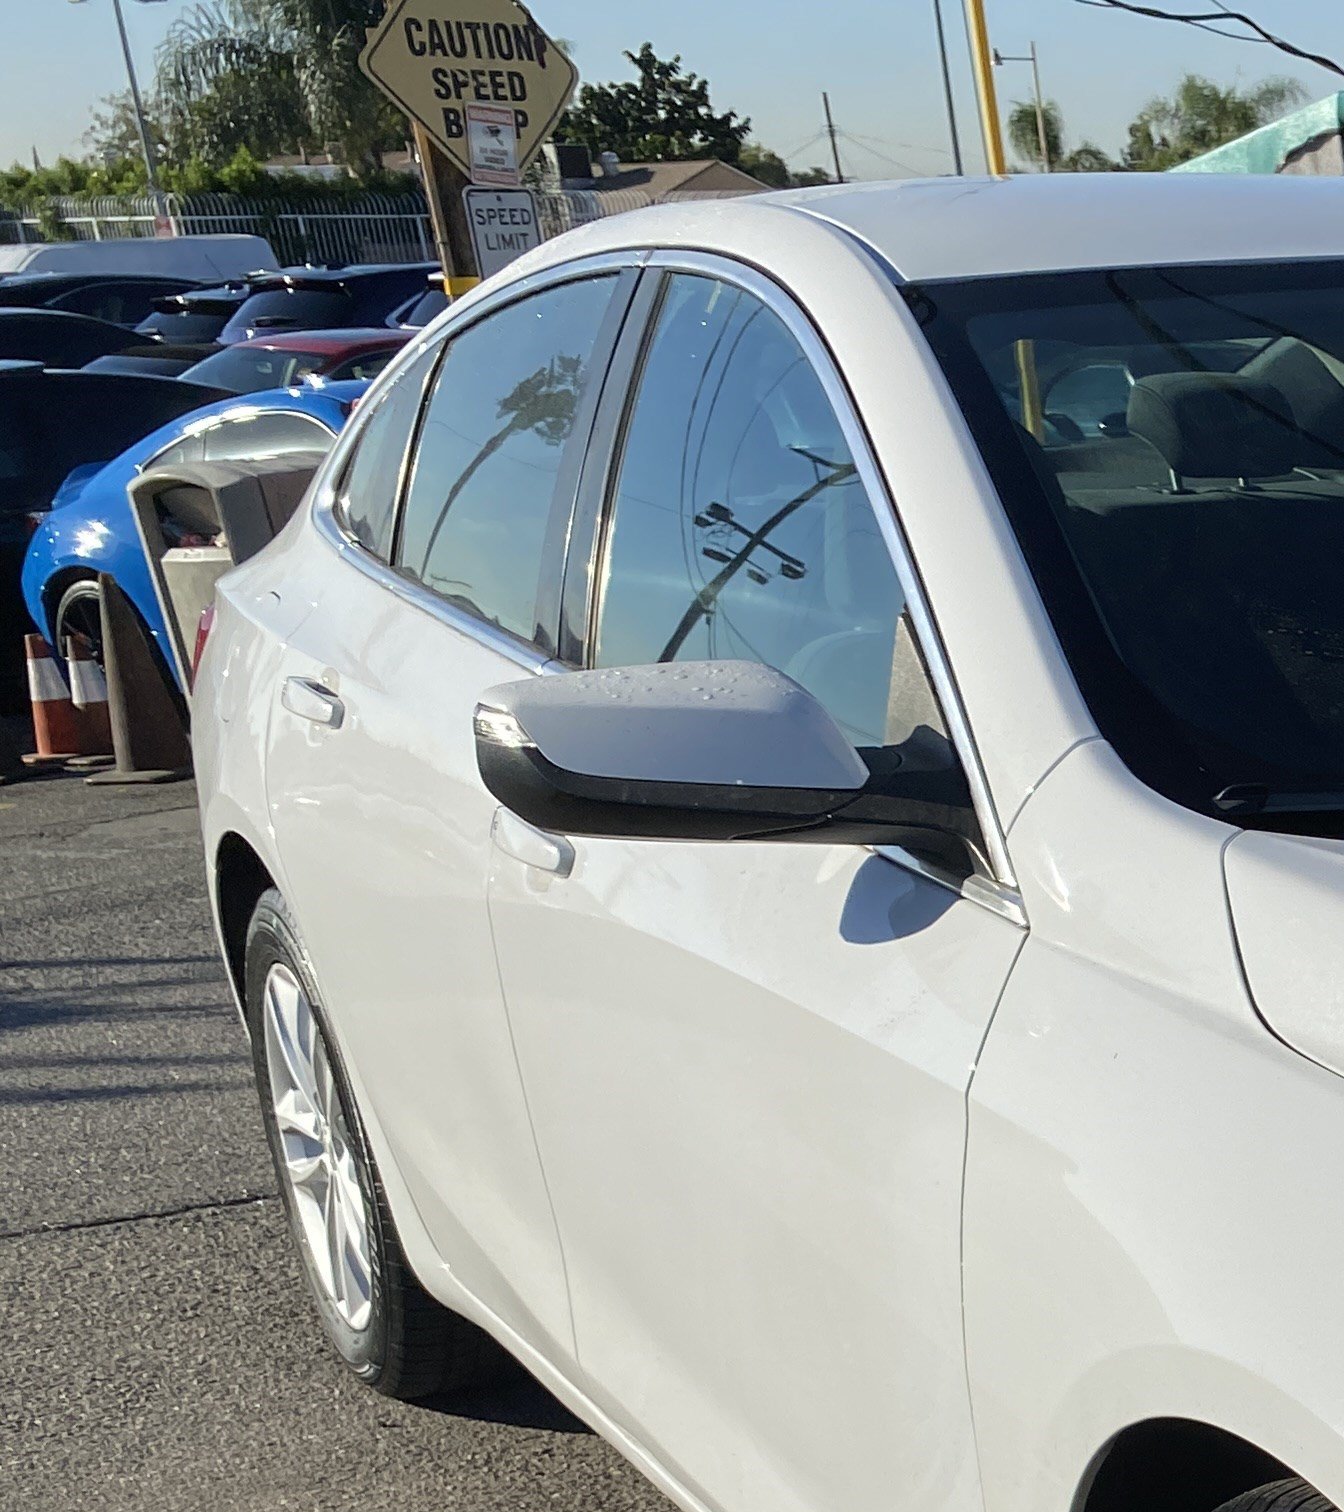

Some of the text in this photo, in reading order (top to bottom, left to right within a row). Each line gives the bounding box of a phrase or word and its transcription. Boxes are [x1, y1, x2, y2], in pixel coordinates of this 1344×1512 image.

[432, 67, 527, 102] SPEED
[442, 107, 529, 140] BP
[475, 208, 532, 226] SPEED
[485, 233, 530, 250] LIMIT
